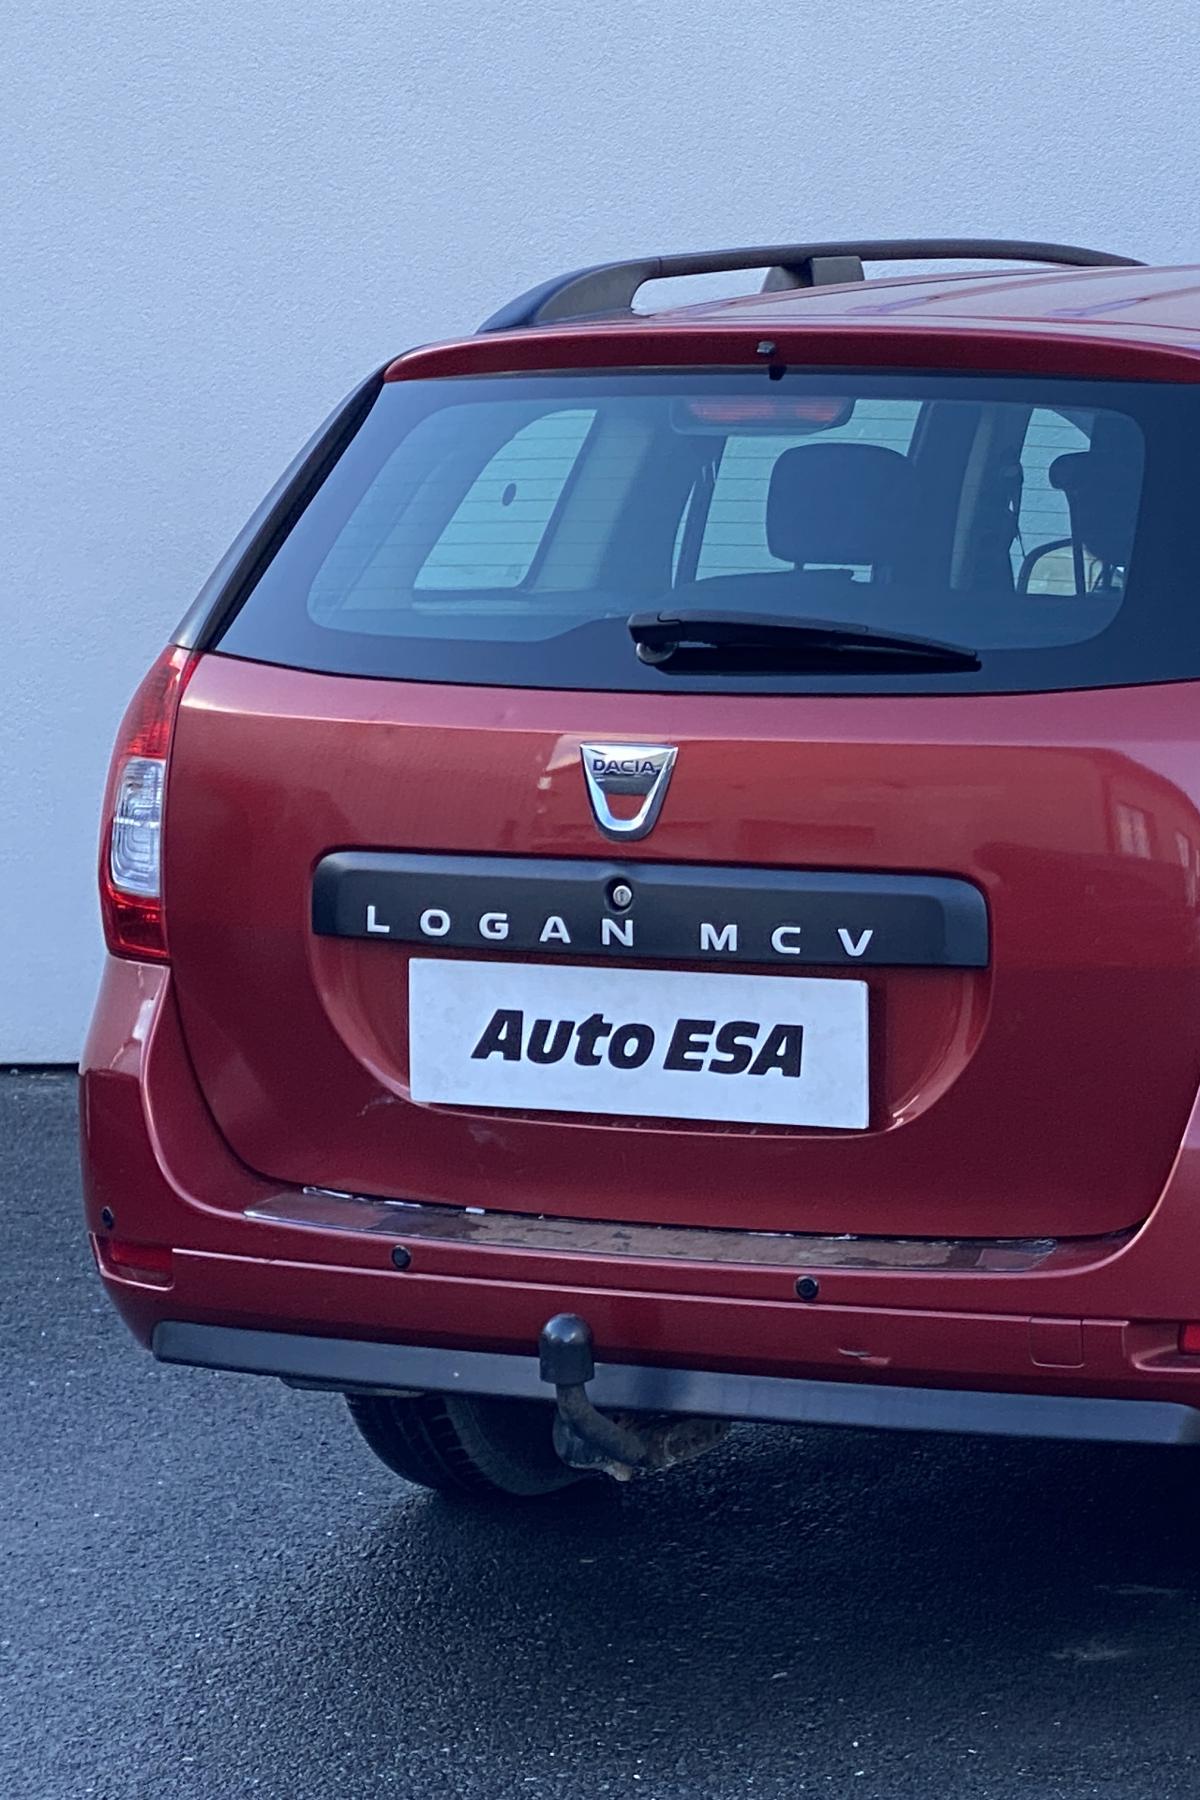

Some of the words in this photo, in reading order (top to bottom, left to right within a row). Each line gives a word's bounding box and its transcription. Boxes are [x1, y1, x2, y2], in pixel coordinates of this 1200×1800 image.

[593, 759, 655, 773] DACIA
[367, 905, 634, 947] LOGAN
[700, 923, 873, 957] MCV
[471, 1009, 655, 1068] Auto
[663, 1018, 803, 1078] ESA
